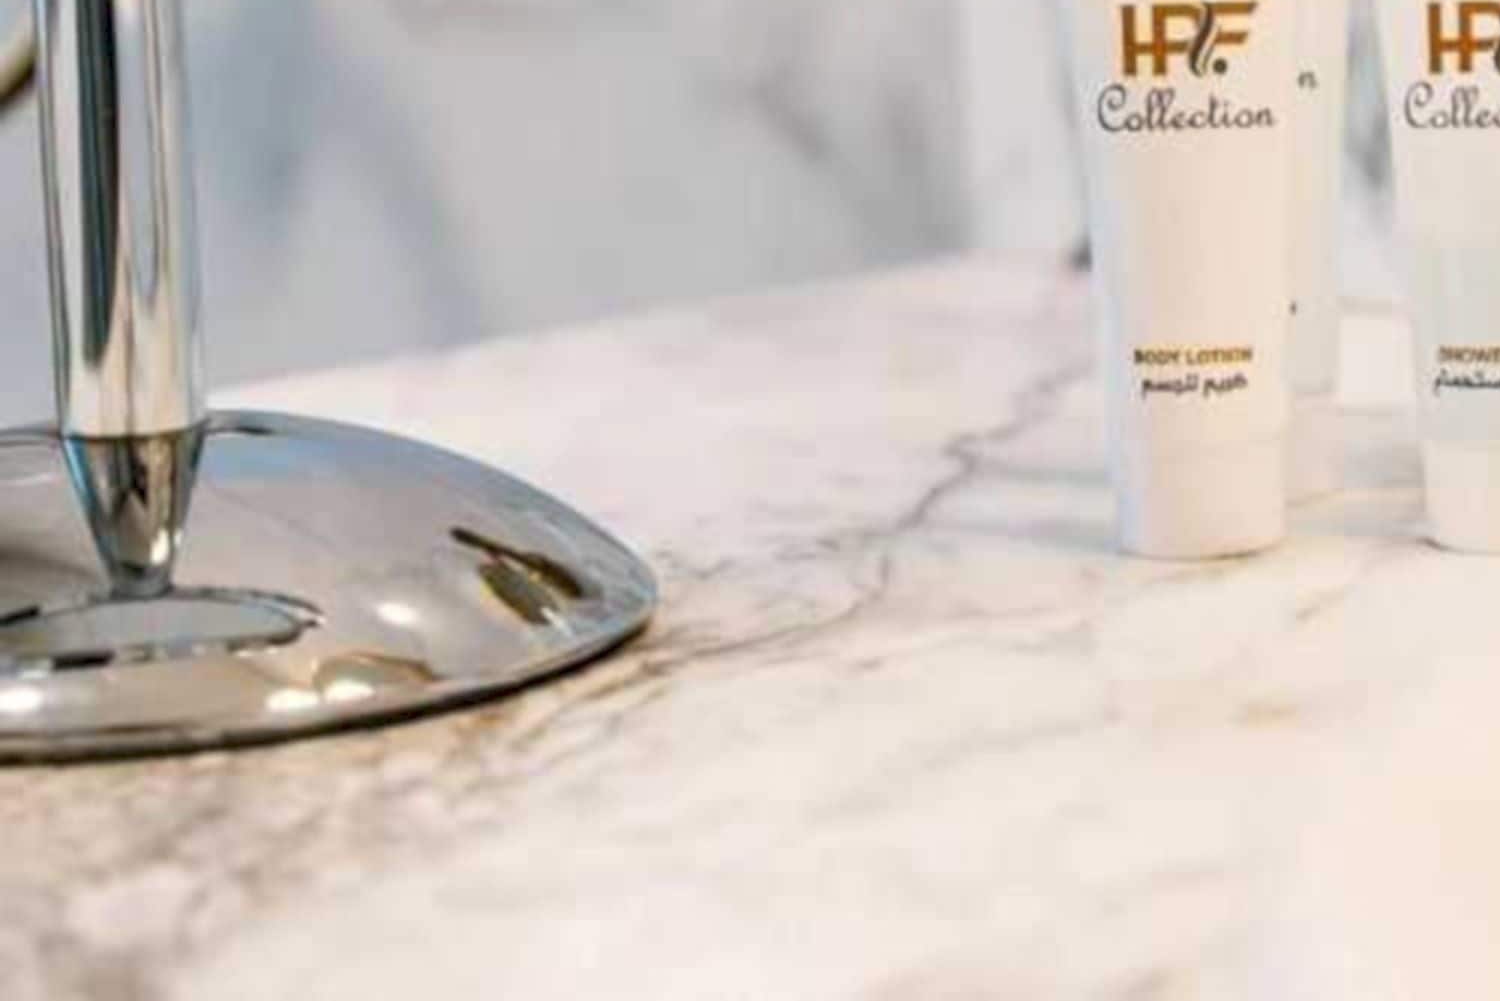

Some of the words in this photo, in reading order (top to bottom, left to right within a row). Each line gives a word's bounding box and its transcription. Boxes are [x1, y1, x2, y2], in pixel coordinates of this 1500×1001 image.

[1097, 82, 1275, 133] Collection
[1133, 349, 1181, 366] BODY
[1186, 348, 1254, 365] LOTION
